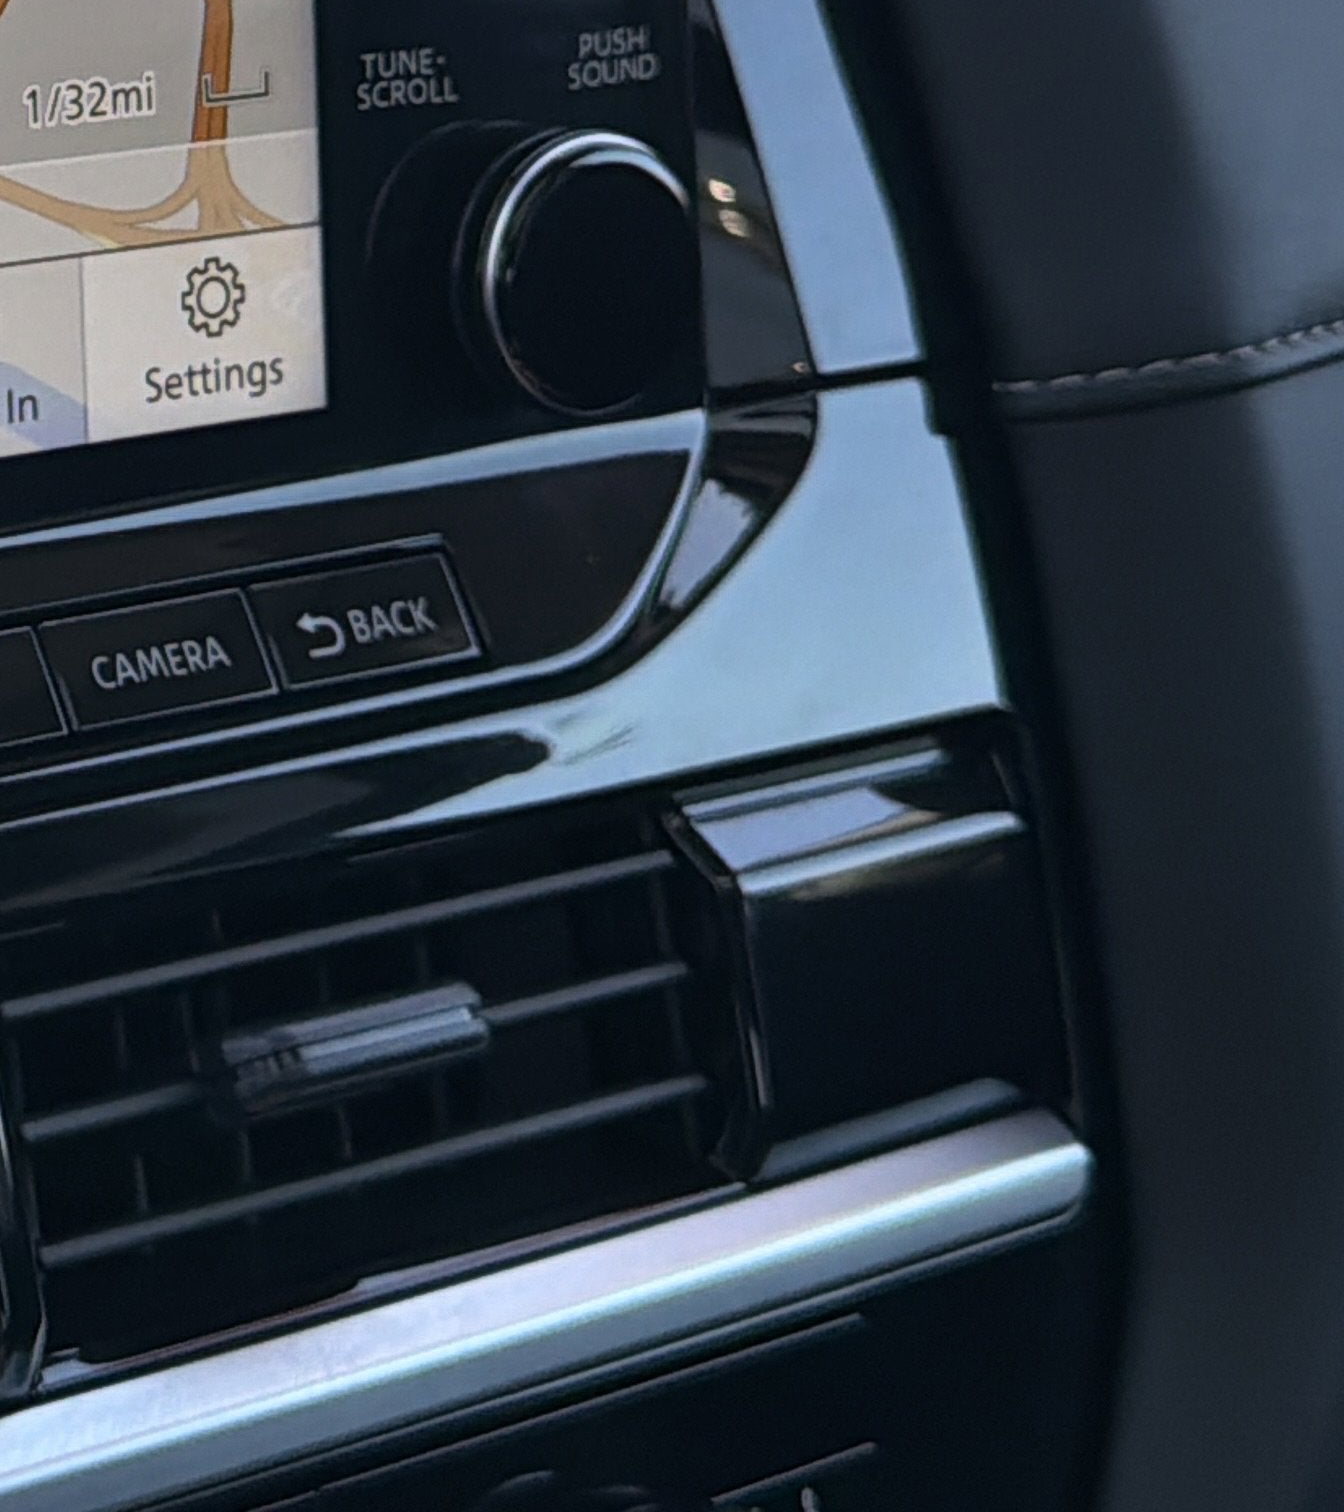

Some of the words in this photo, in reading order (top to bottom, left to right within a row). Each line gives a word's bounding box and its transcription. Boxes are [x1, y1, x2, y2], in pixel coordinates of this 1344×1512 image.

[578, 25, 650, 59] PUSH
[568, 54, 661, 90] SOUND
[25, 75, 155, 127] 1/32mi
[356, 76, 460, 112] SCROLL
[145, 356, 284, 403] Settings
[7, 390, 39, 424] In
[348, 595, 438, 645] BACK
[91, 636, 232, 690] CAMERA
